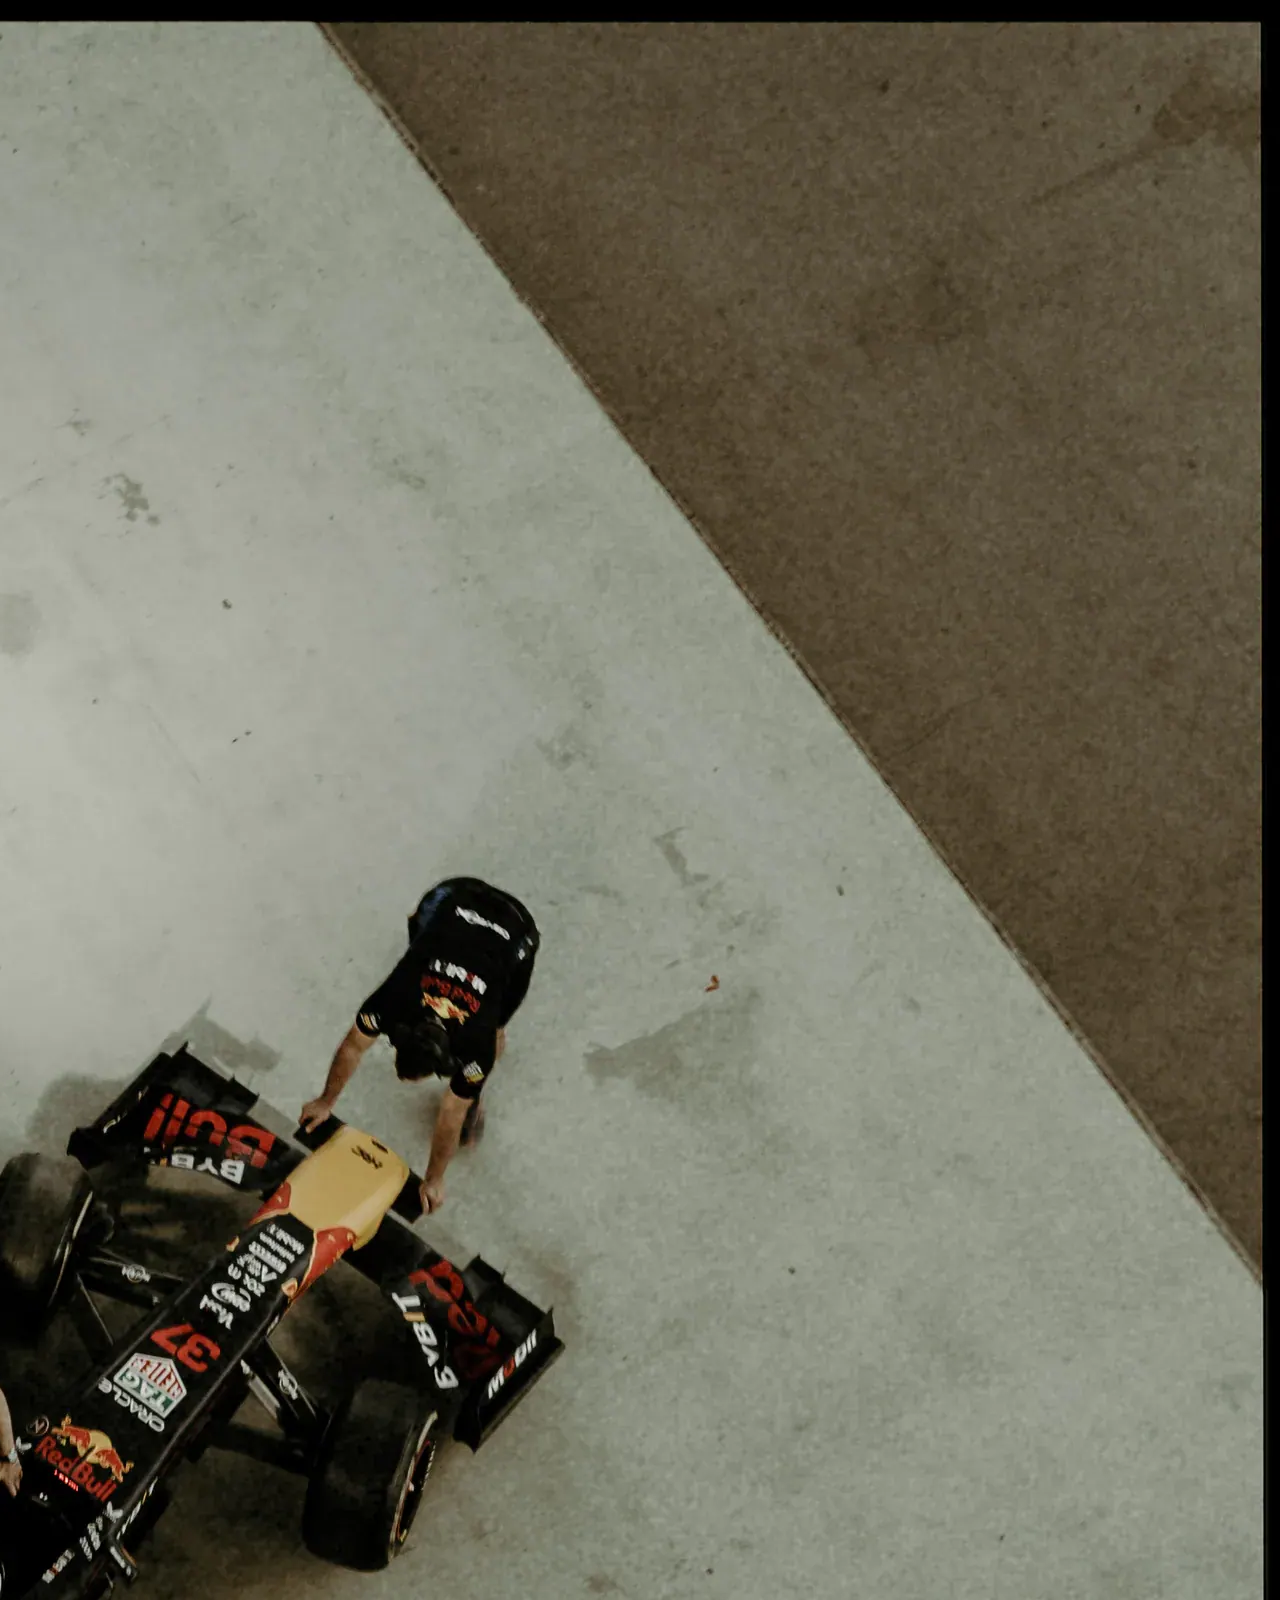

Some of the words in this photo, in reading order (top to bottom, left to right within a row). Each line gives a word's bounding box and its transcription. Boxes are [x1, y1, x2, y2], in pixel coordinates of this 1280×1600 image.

[149, 1321, 221, 1374] 37
[97, 1376, 166, 1433] ORACLE
[124, 1369, 170, 1411] TAG
[33, 1434, 82, 1475] Red
[70, 1461, 118, 1504] Bull
